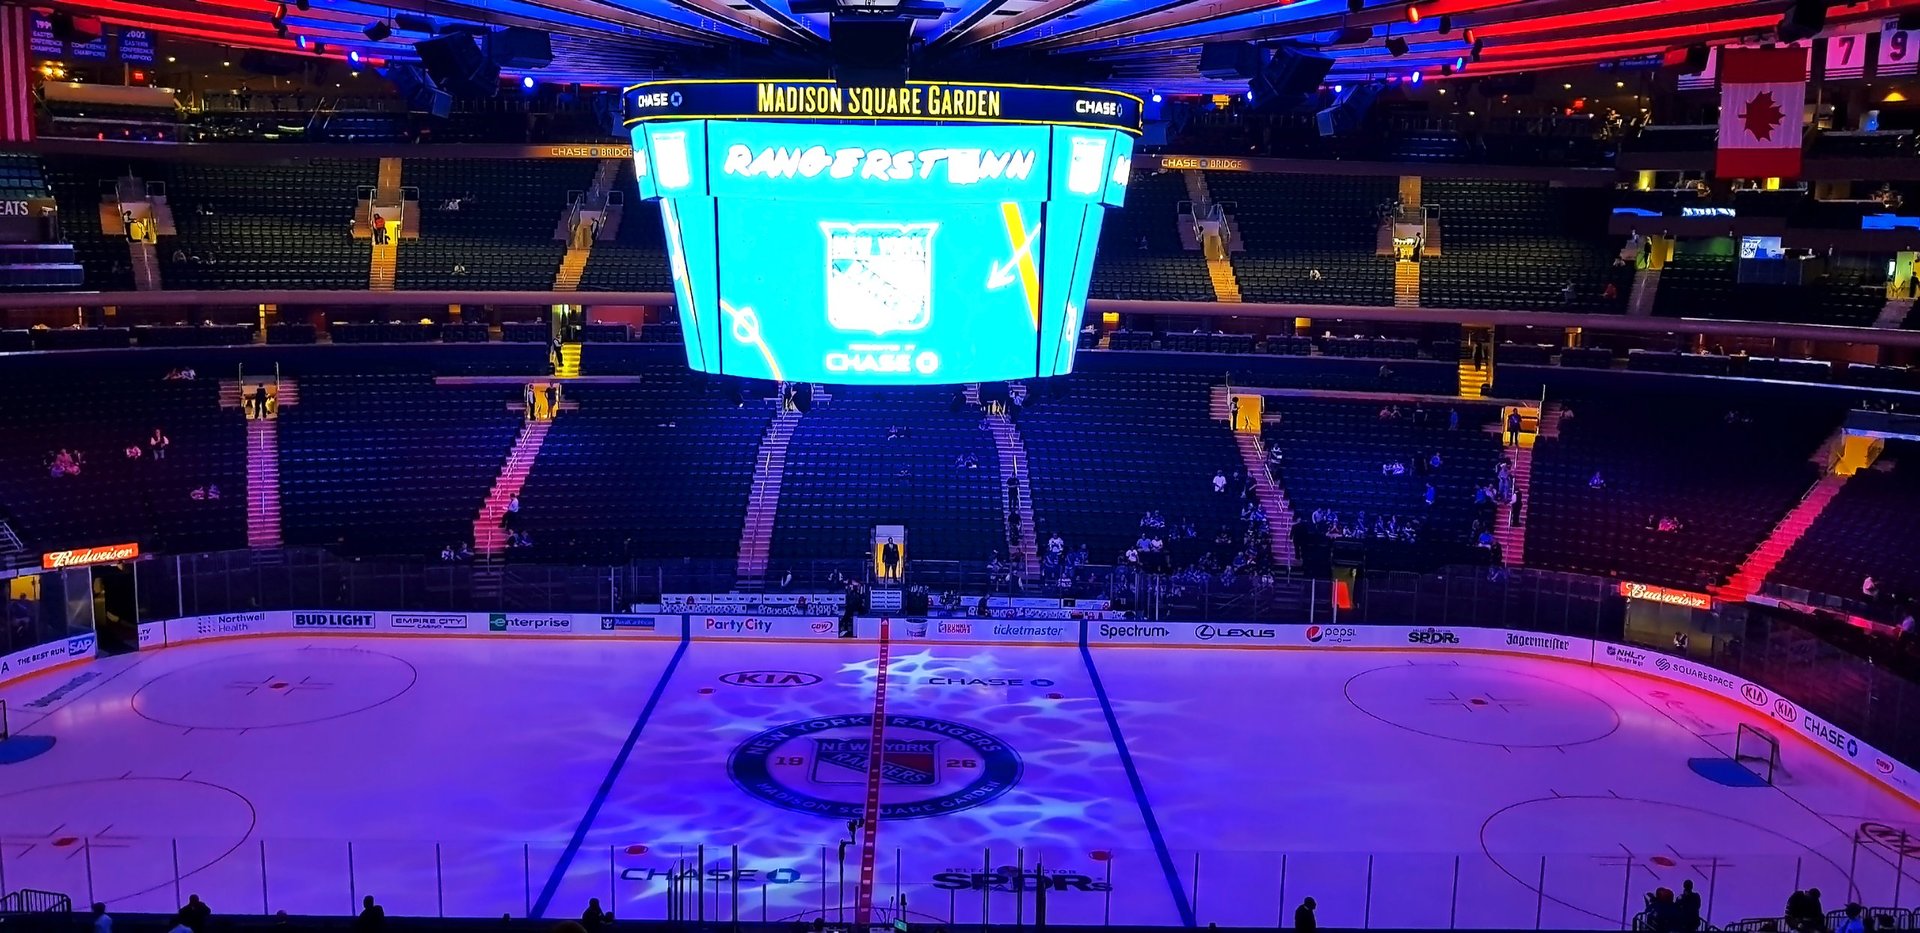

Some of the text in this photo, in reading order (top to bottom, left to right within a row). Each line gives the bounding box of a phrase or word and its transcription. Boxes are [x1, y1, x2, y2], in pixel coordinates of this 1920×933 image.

[1837, 36, 1856, 66] 7
[1889, 30, 1908, 61] 9
[638, 93, 668, 107] CHASE
[757, 83, 1000, 117] MADISON SQUARE GARDEN
[1075, 99, 1116, 116] CHASE
[551, 148, 633, 157] CHASE BRIDGE
[1161, 159, 1242, 168] CHASE BRIDGE
[826, 353, 912, 372] CHASE
[50, 547, 133, 567] Budweiser
[1626, 582, 1705, 607] Budweiser
[218, 613, 265, 624] Northwell
[295, 614, 372, 625] BUD LIGHT
[491, 616, 570, 631] enterprise
[218, 623, 248, 632] Health
[993, 624, 1064, 636] ticketmaster
[1100, 624, 1165, 639] Spectrum
[1217, 628, 1275, 638] LEXUS
[1325, 628, 1355, 637] pepsi
[69, 639, 93, 654] SAP
[17, 647, 66, 666] THE BEST RUN
[736, 673, 805, 684] KIA
[928, 678, 1023, 687] CHASE
[1673, 664, 1734, 689] SQUARESPACE
[1745, 686, 1763, 702] KIA
[1778, 704, 1794, 720] KIA
[746, 716, 1003, 755] NEW YORK RANGERS
[1804, 716, 1845, 750] CHASE
[821, 742, 932, 752] NEW YORK
[946, 759, 976, 768] 26
[756, 781, 1001, 815] MADISON SQUARE GARDEN
[620, 868, 758, 881] CHASE
